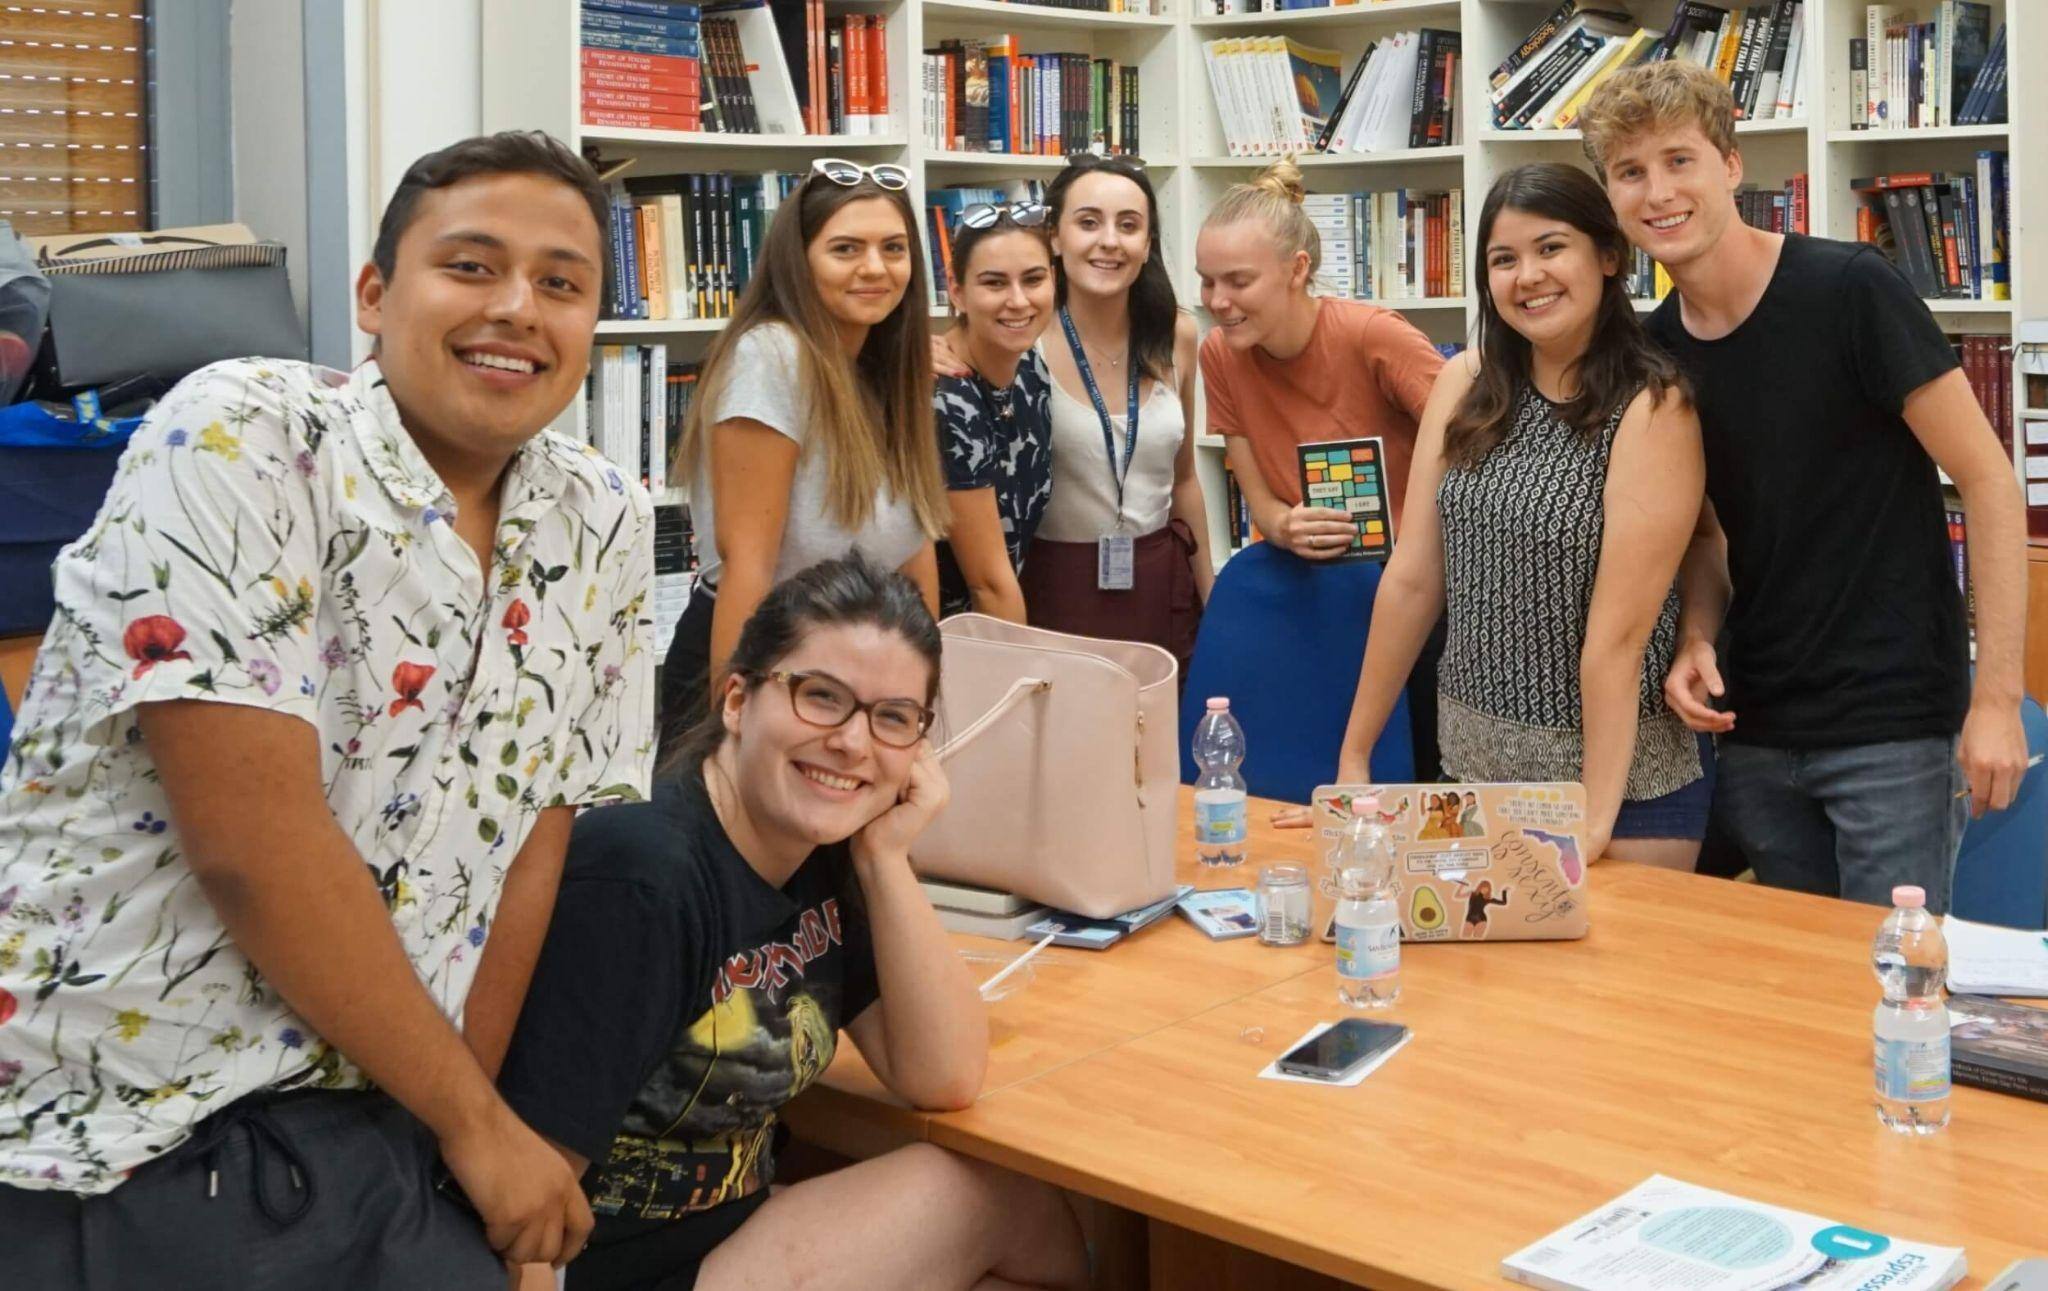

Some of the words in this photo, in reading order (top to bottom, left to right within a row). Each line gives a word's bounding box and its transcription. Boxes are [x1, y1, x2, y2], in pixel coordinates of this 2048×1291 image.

[1520, 23, 1556, 58] Sociology
[1742, 18, 1757, 47] SPORT
[1755, 16, 1770, 44] SPORT
[1734, 46, 1749, 73] ITALIA
[1747, 44, 1762, 72] ITALIA
[1832, 1234, 1873, 1251] 1
